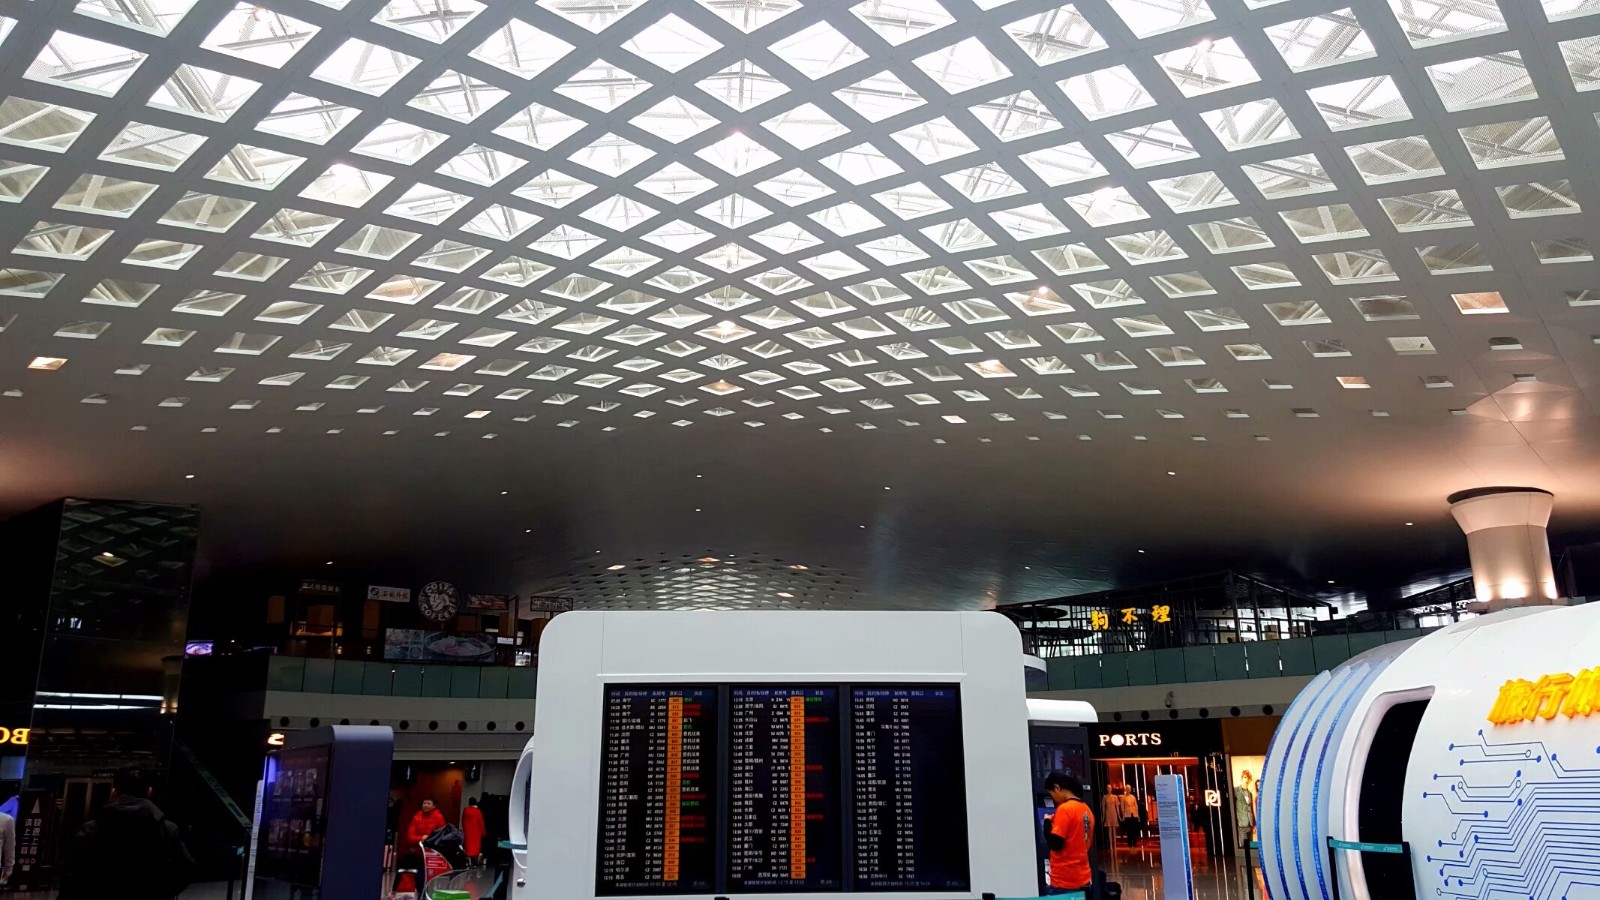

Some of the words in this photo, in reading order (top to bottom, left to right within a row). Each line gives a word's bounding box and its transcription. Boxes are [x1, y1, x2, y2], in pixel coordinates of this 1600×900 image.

[425, 583, 454, 596] COSTA
[420, 602, 457, 621] COFFEE
[1091, 605, 1171, 630] 狗不理
[1098, 733, 1161, 746] PORTS
